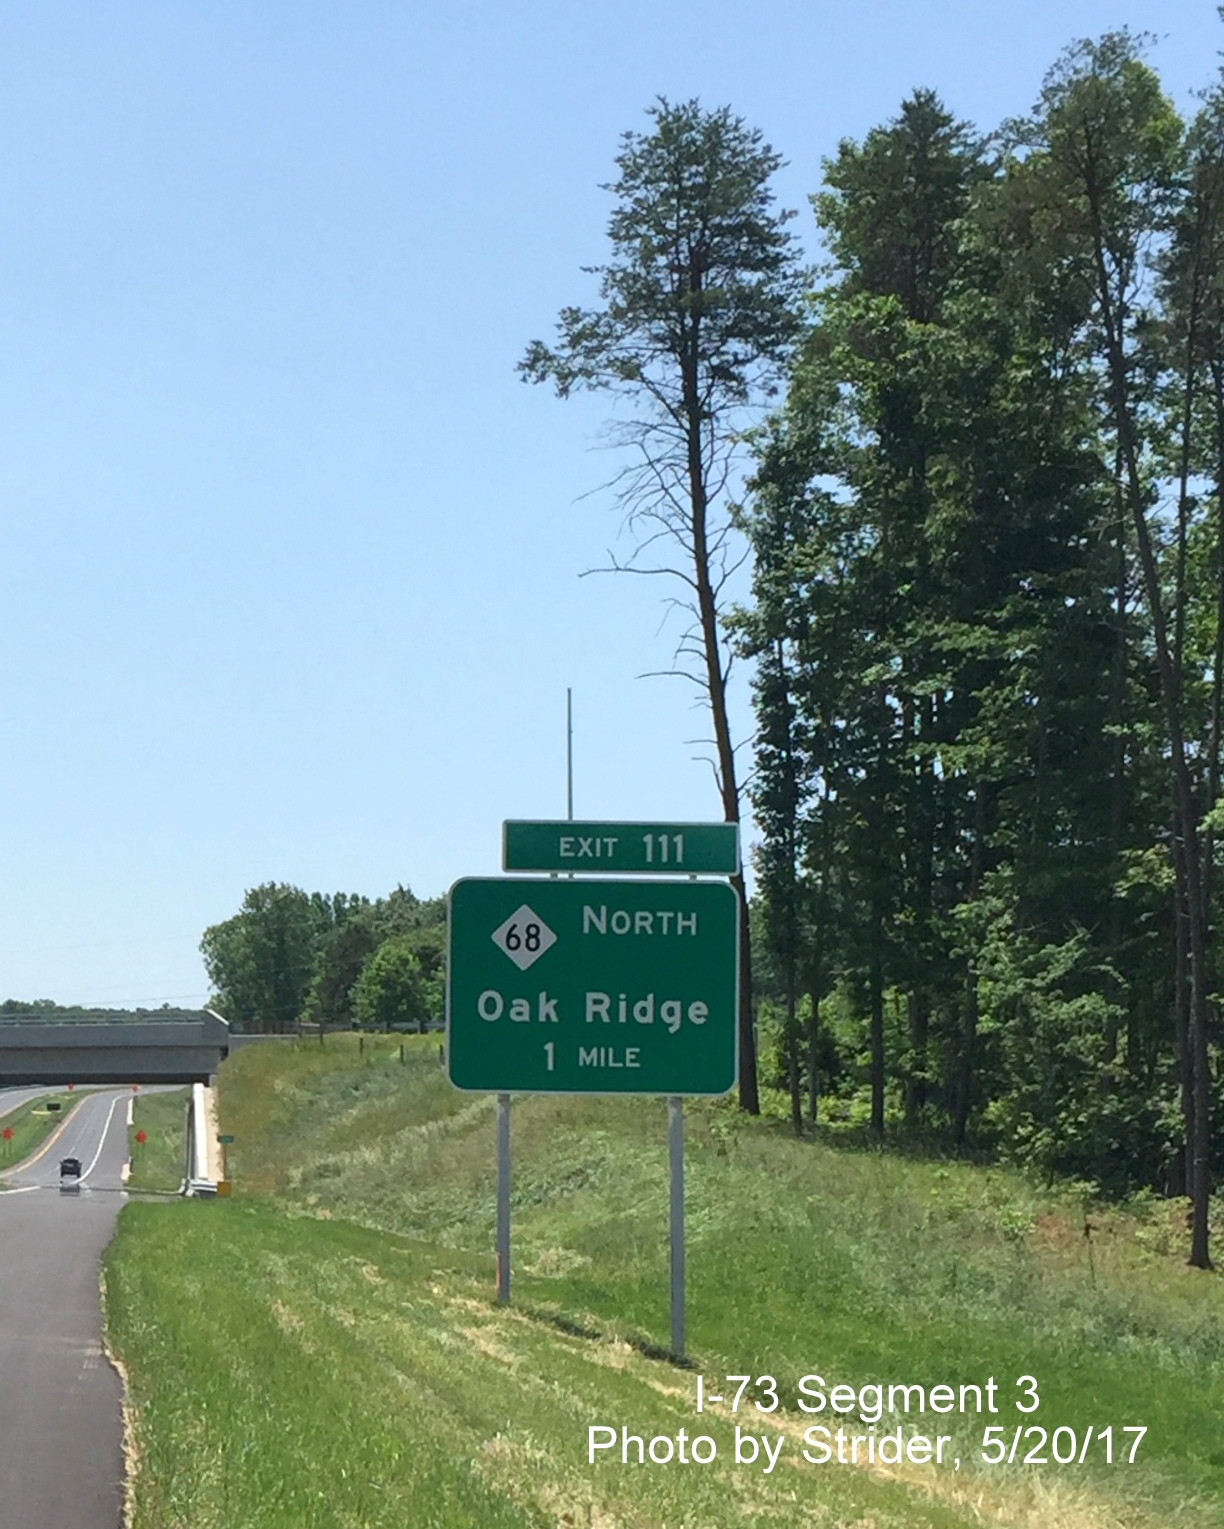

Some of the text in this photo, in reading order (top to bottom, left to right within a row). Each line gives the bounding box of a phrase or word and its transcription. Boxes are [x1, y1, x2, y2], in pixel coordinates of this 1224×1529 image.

[559, 834, 683, 863] EXIT 111
[505, 905, 697, 952] 68 NORTH
[477, 990, 709, 1034] Oak Ridge
[543, 1042, 641, 1071] 1 MILE
